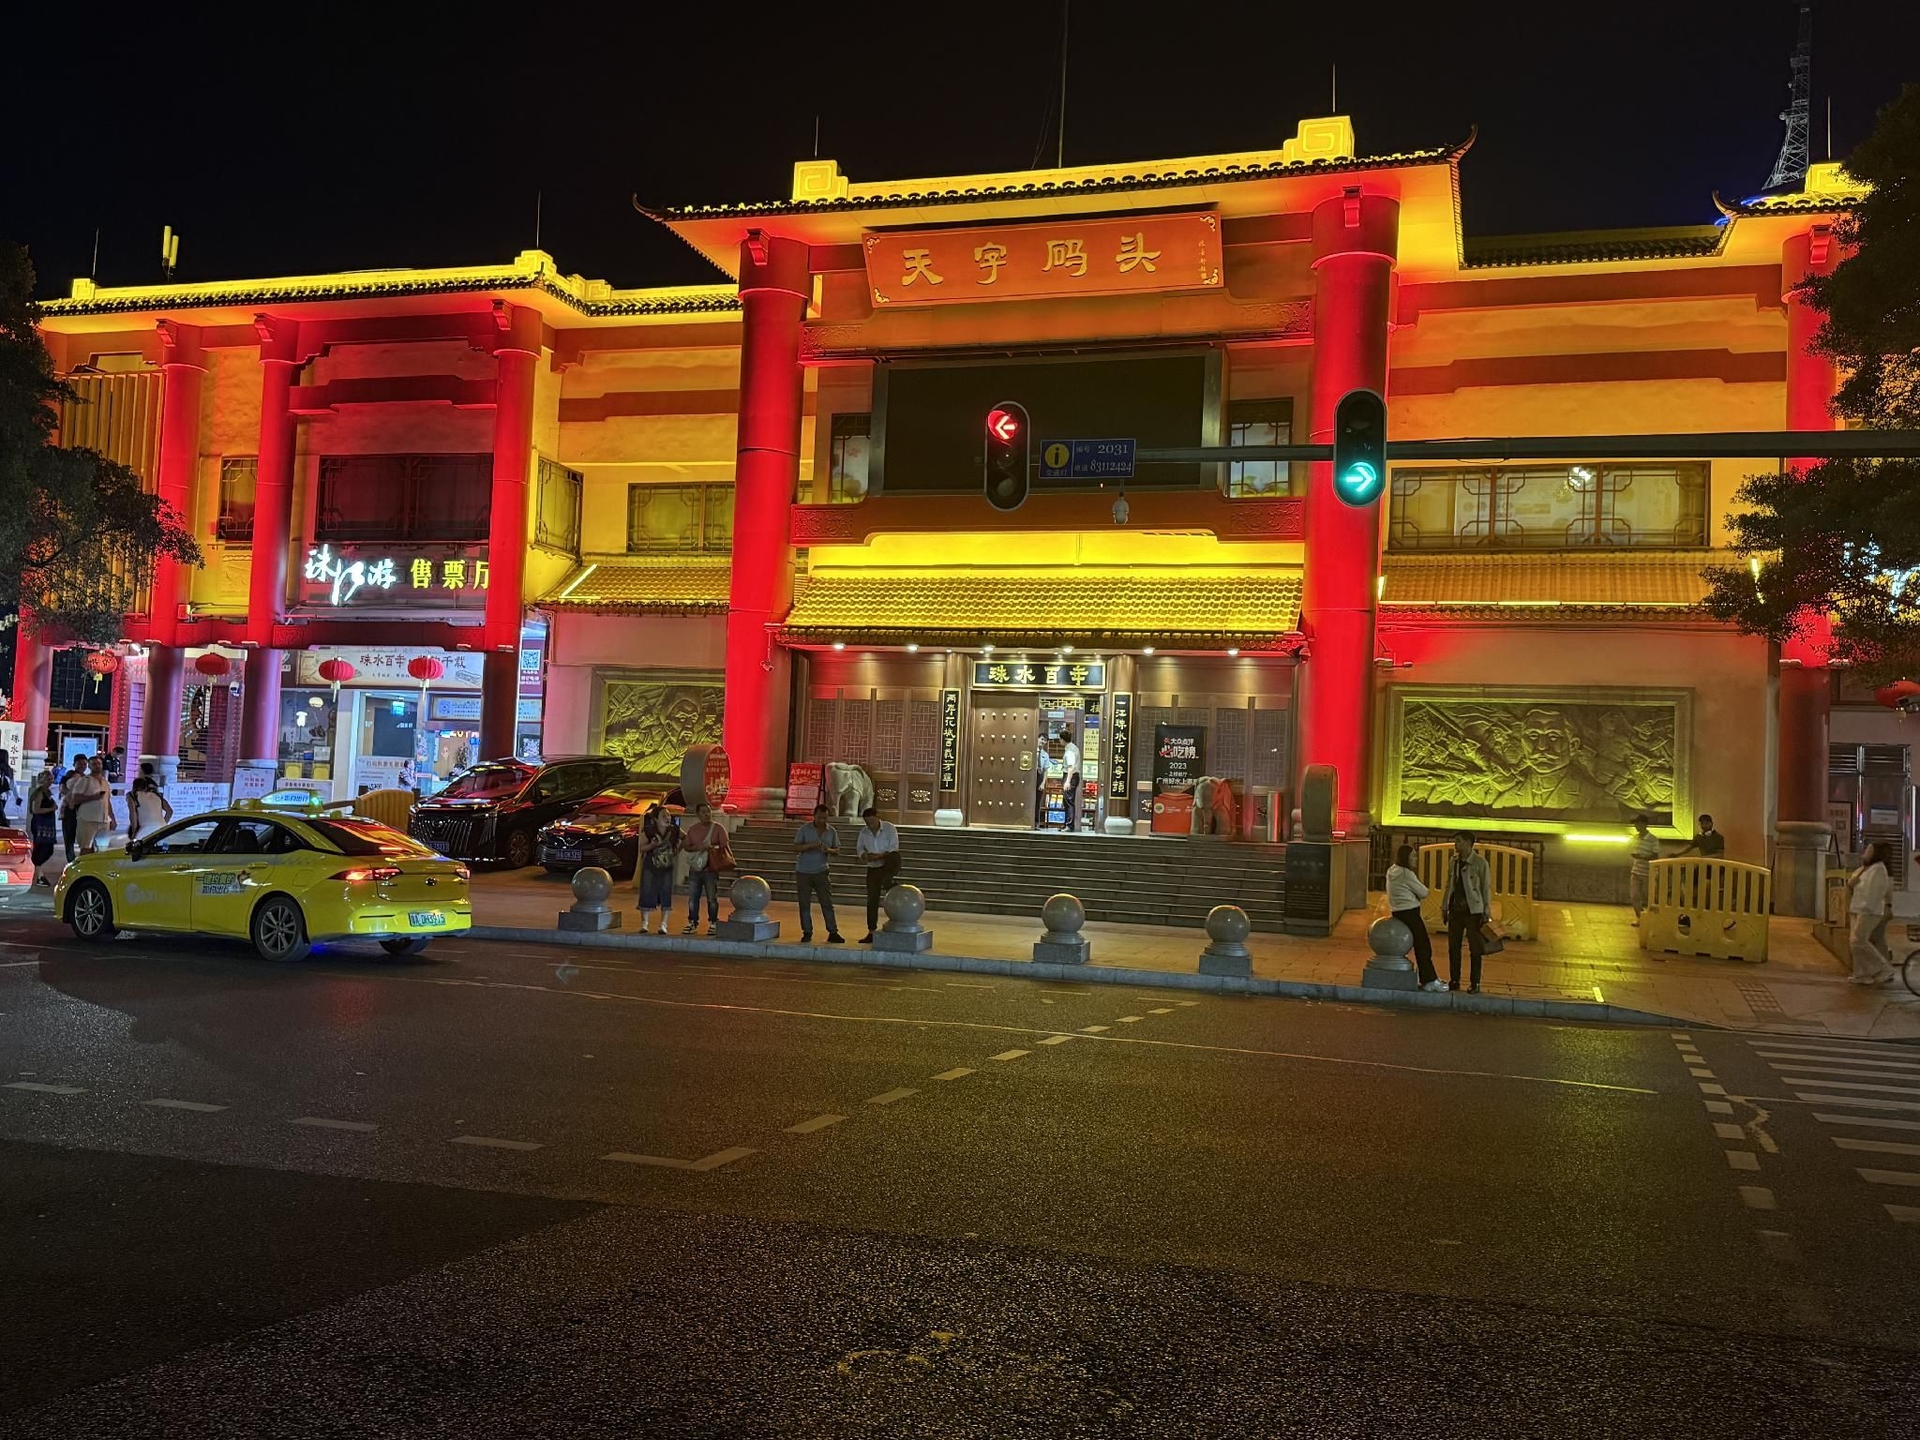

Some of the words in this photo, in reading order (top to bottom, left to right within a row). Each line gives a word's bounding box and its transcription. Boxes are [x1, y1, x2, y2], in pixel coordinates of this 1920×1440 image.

[900, 231, 1161, 286] 天字码头
[1097, 444, 1129, 456] 2031
[1090, 459, 1132, 473] 83112424
[988, 665, 1089, 687] 珠水百年
[1158, 745, 1196, 759] 必吃榜
[1169, 762, 1187, 770] 2023
